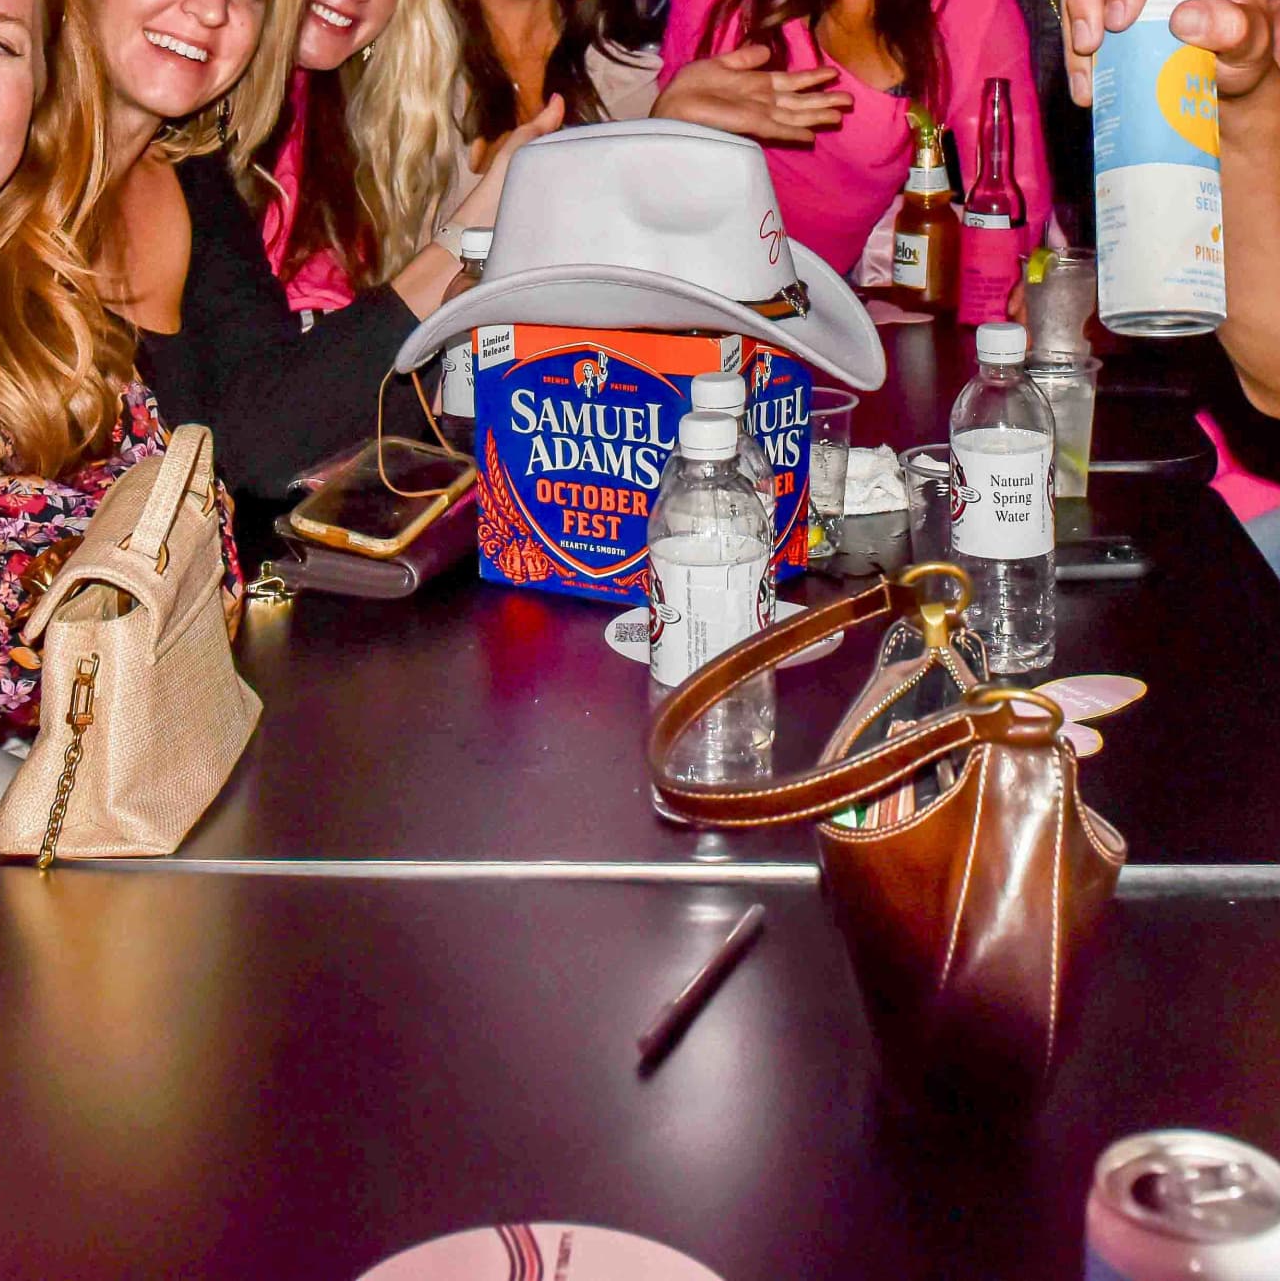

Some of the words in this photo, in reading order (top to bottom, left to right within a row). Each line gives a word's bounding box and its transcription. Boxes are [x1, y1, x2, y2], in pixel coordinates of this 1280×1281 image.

[482, 331, 510, 349] Limited
[483, 343, 510, 359] Release
[610, 383, 638, 393] PATRIOT
[511, 389, 675, 451] SAMUEL
[525, 437, 660, 490] ADAMS
[990, 473, 1034, 487] Natural
[536, 478, 648, 517] OCTOBER
[993, 491, 1032, 508] Spring
[995, 510, 1031, 523] Water
[563, 510, 621, 541] FEST
[560, 540, 588, 552] HEARTY
[589, 543, 595, 552] &
[596, 545, 626, 557] SMOOTH
